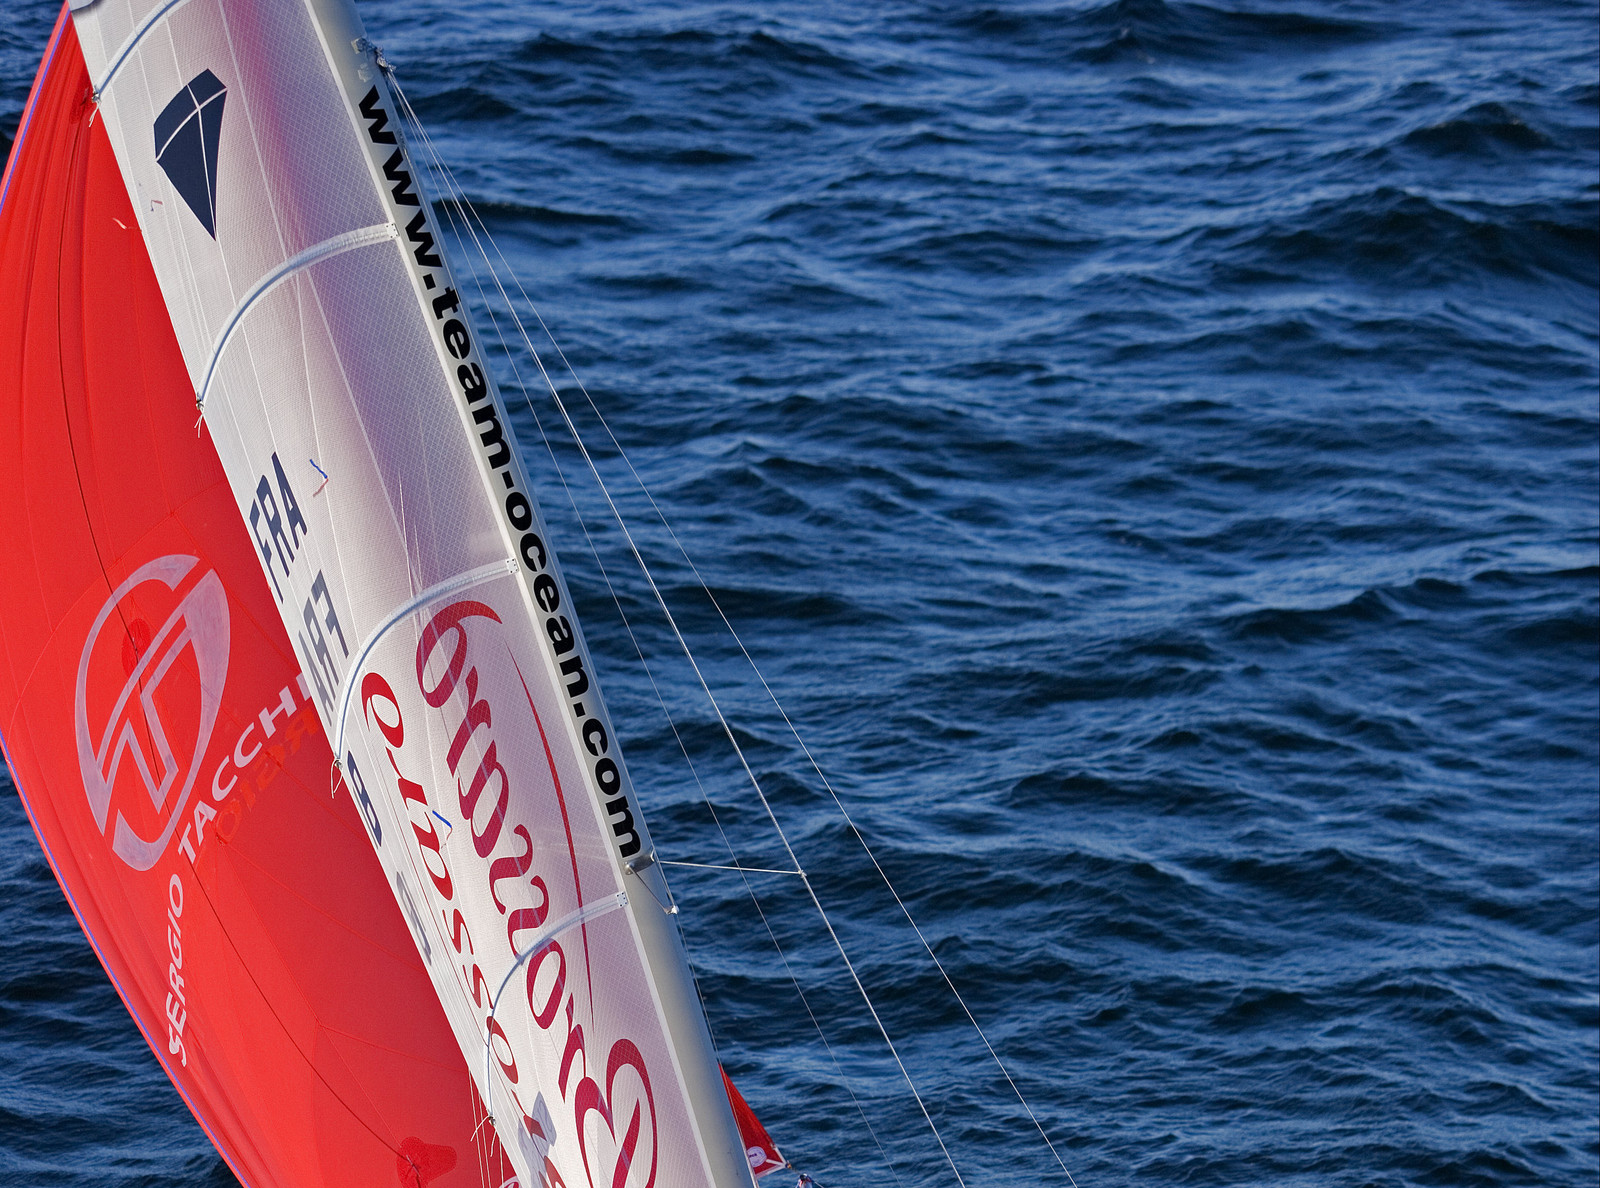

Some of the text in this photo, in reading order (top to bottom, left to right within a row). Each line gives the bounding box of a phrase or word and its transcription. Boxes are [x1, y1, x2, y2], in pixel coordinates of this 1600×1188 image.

[250, 452, 308, 604] FRA
[359, 85, 642, 858] www.team-ocean.com
[165, 873, 187, 1067] SERGIO
